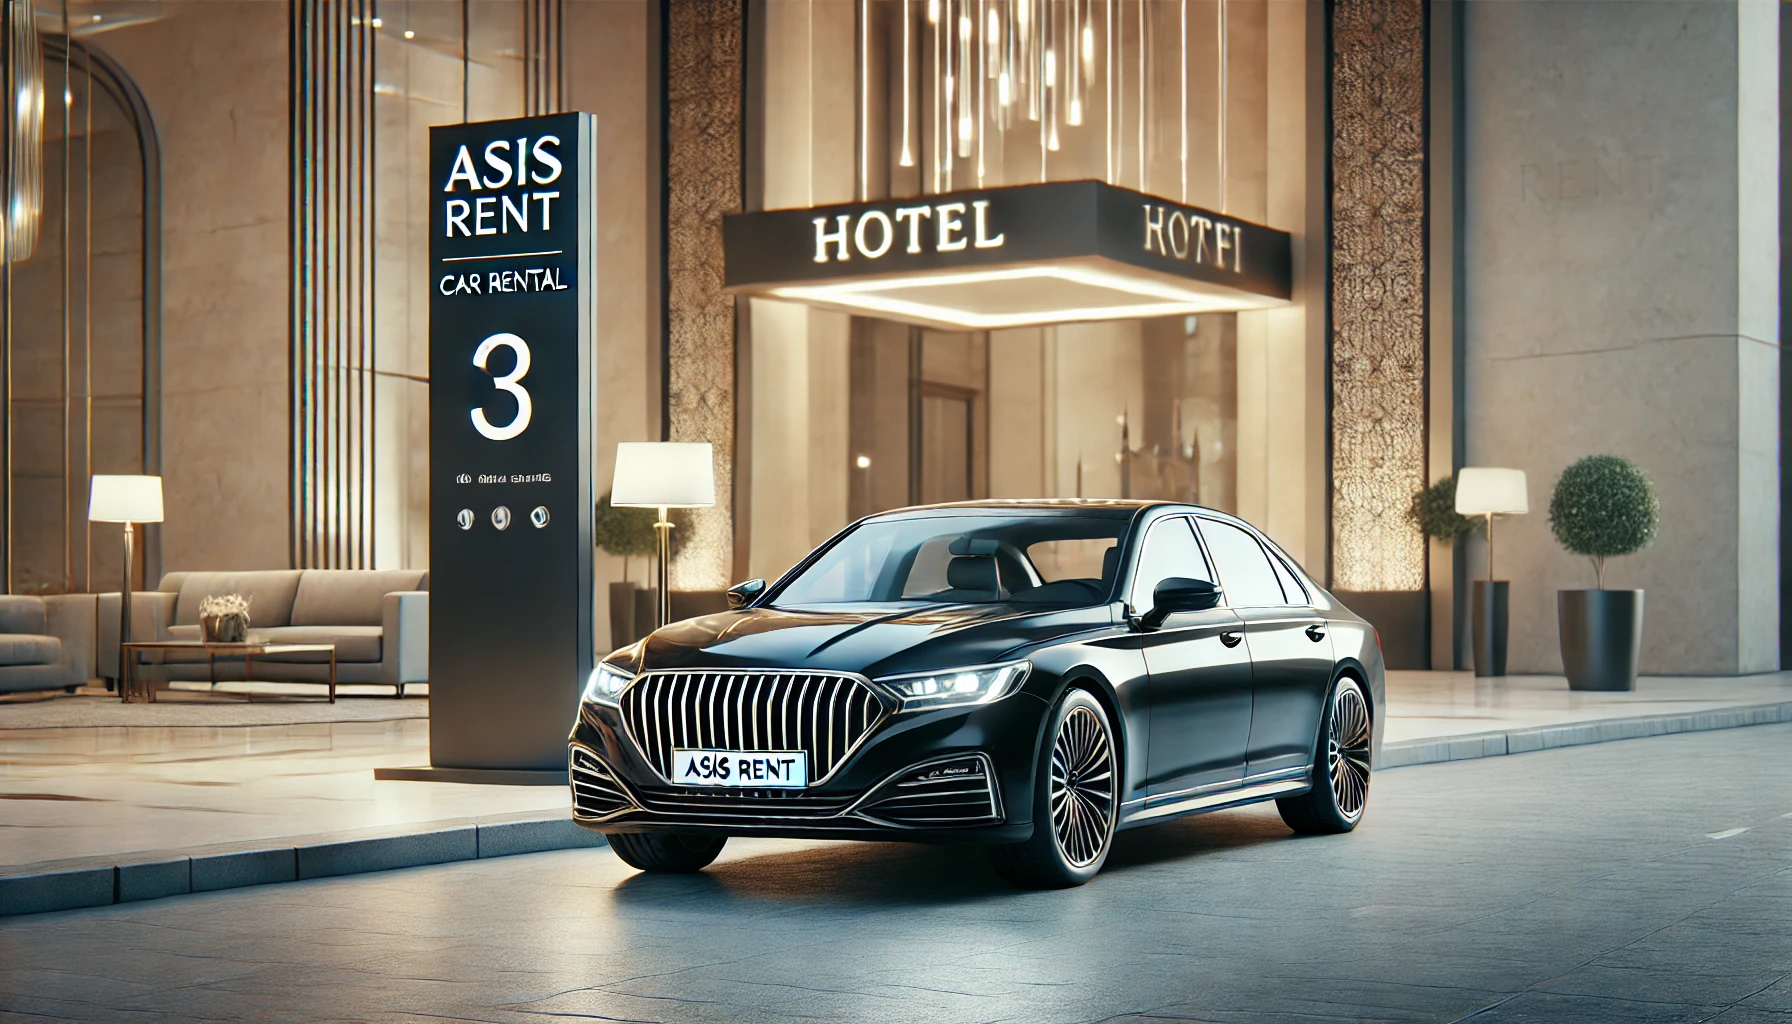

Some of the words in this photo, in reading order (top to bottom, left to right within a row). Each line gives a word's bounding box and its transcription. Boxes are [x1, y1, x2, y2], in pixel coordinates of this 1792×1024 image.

[444, 135, 563, 192] ASIS
[446, 191, 560, 238] RENT
[812, 200, 1005, 264] HOTEL
[439, 273, 482, 296] CAR
[488, 267, 569, 294] RENTAL
[470, 332, 533, 441] 3
[684, 752, 731, 780] ASIS
[738, 757, 796, 782] RENT
